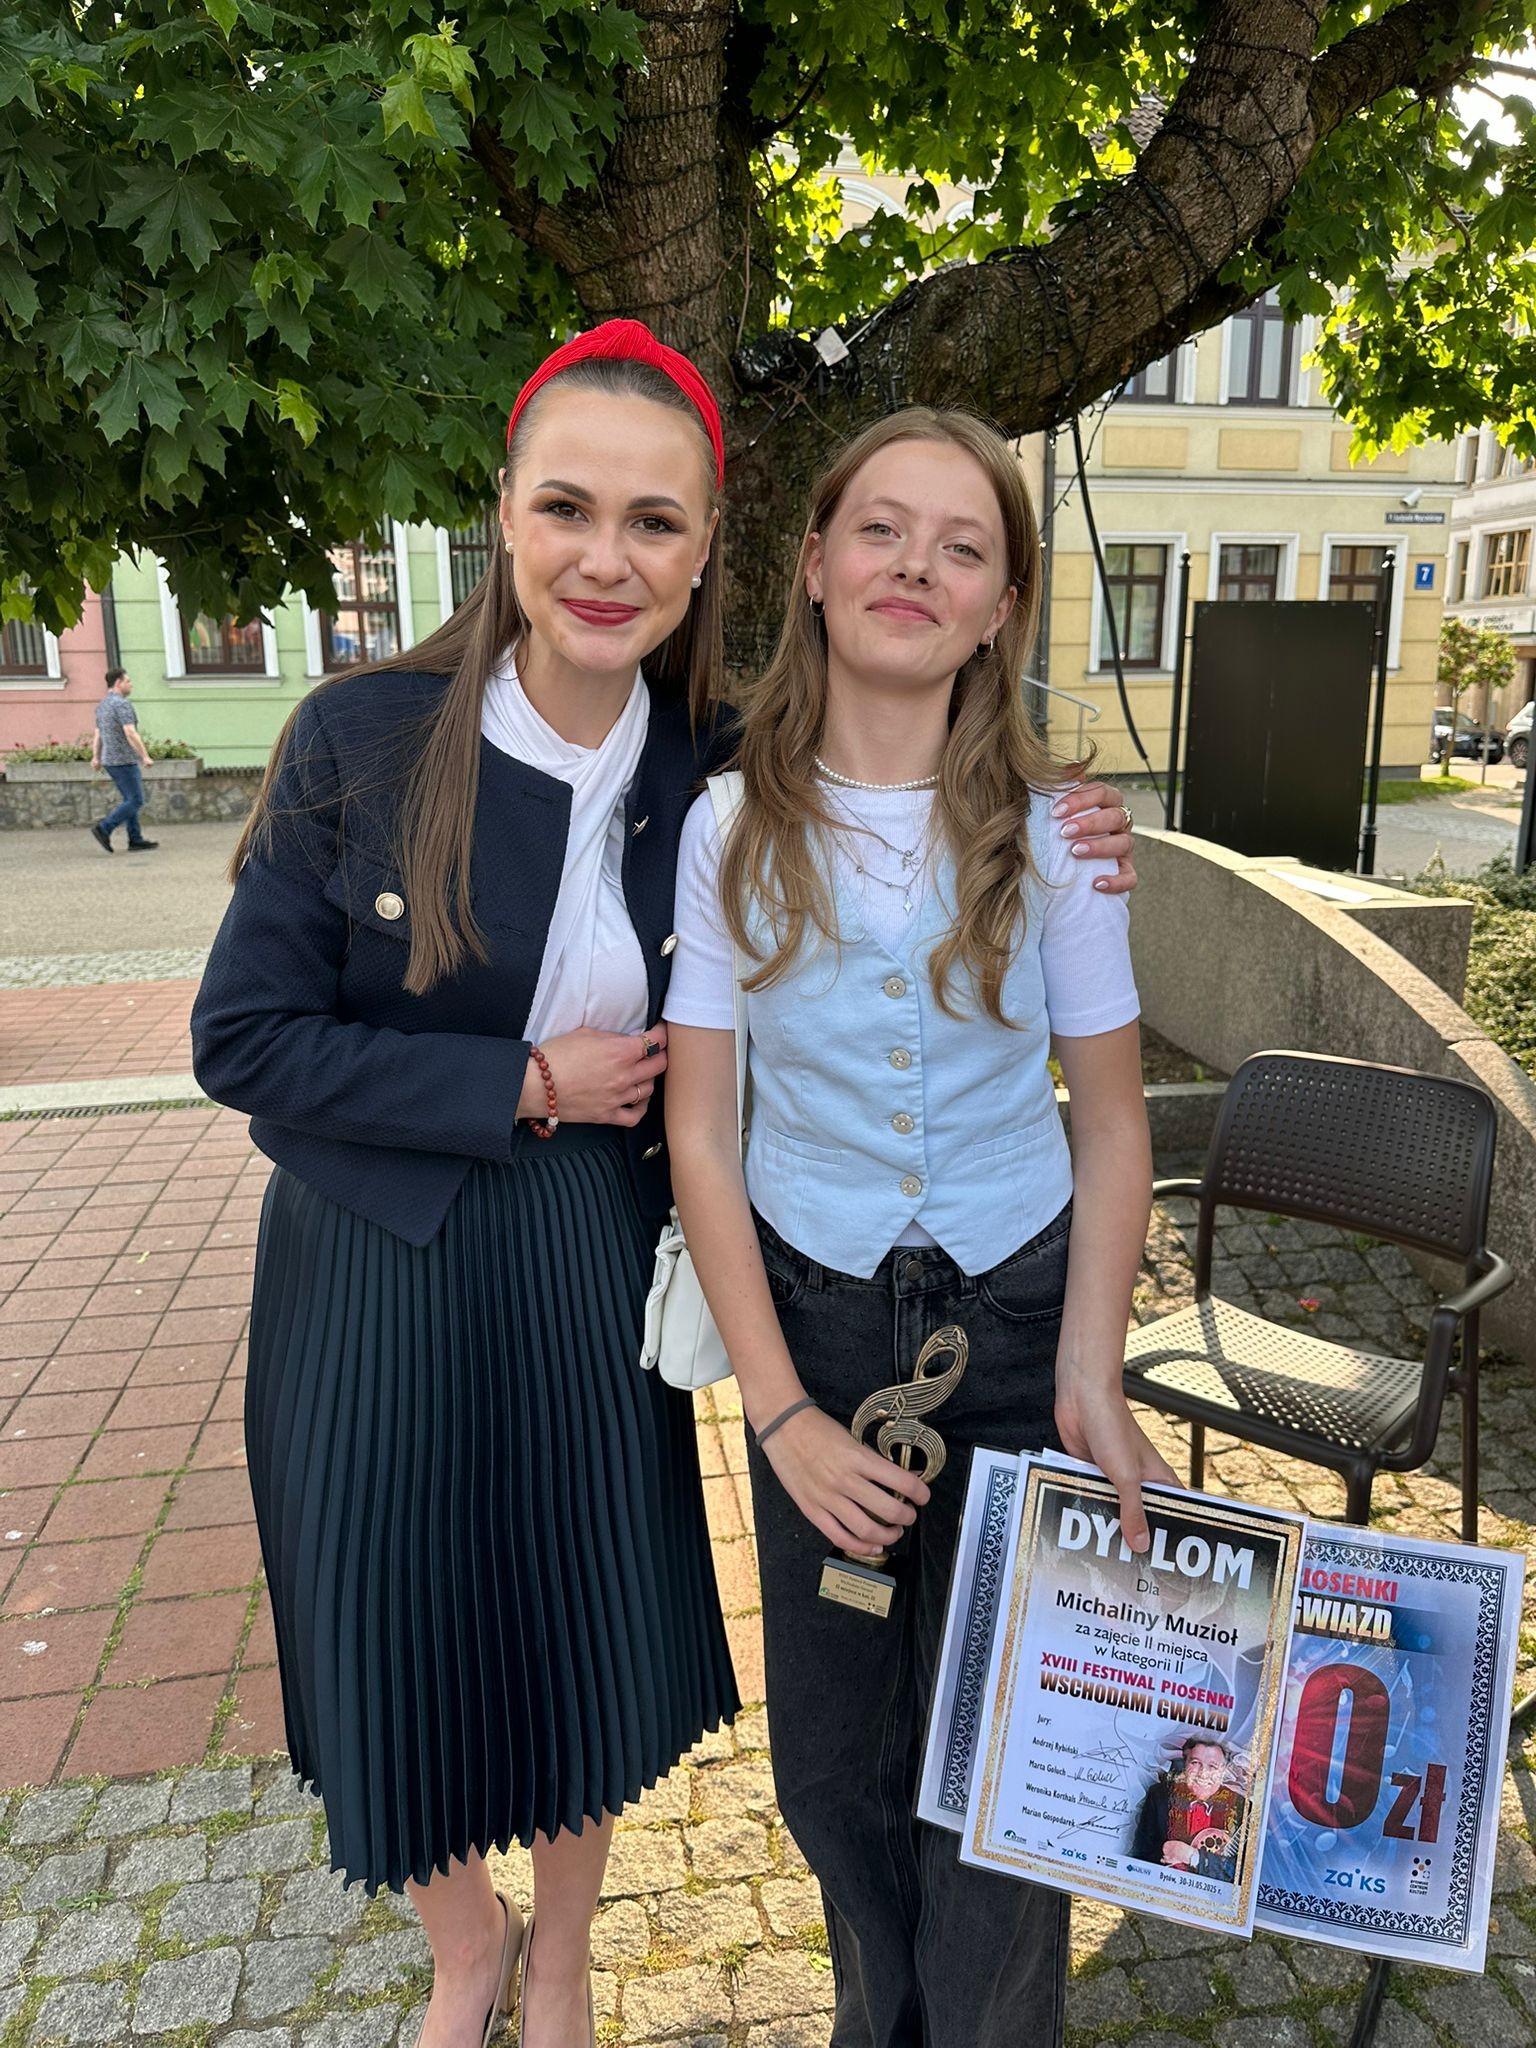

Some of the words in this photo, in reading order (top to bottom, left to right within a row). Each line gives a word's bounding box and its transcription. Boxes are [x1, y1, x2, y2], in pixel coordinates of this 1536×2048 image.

[1421, 566, 1430, 582] 7
[1136, 1578, 1160, 1597] Dla
[1301, 1567, 1399, 1603] IOSENKI
[1056, 1589, 1160, 1632] Michaliny
[1165, 1613, 1239, 1646] Muzioł
[1075, 1623, 1091, 1636] za
[1094, 1627, 1141, 1647] zajęcie
[1144, 1636, 1153, 1649] II
[1157, 1642, 1209, 1662] miejsca
[1094, 1645, 1108, 1657] w
[1111, 1646, 1172, 1672] kategorii
[1175, 1661, 1184, 1675] II
[1040, 1652, 1078, 1673] XVIII
[1082, 1661, 1156, 1691] FESTIWAL
[1161, 1680, 1235, 1710] PIOSENKI
[1040, 1670, 1154, 1716] WSCHODAMI
[1157, 1698, 1230, 1733] GWIAZD
[1037, 1713, 1052, 1726] Jury:
[1031, 1736, 1053, 1751] Andrzej
[1028, 1759, 1045, 1771] Marta
[1025, 1782, 1052, 1797] Weronika
[1382, 1762, 1448, 1844] zł
[1021, 1805, 1042, 1818] Marian
[1042, 1811, 1076, 1828] Gospodarek
[1179, 1876, 1217, 1894] 30-31.05.2025
